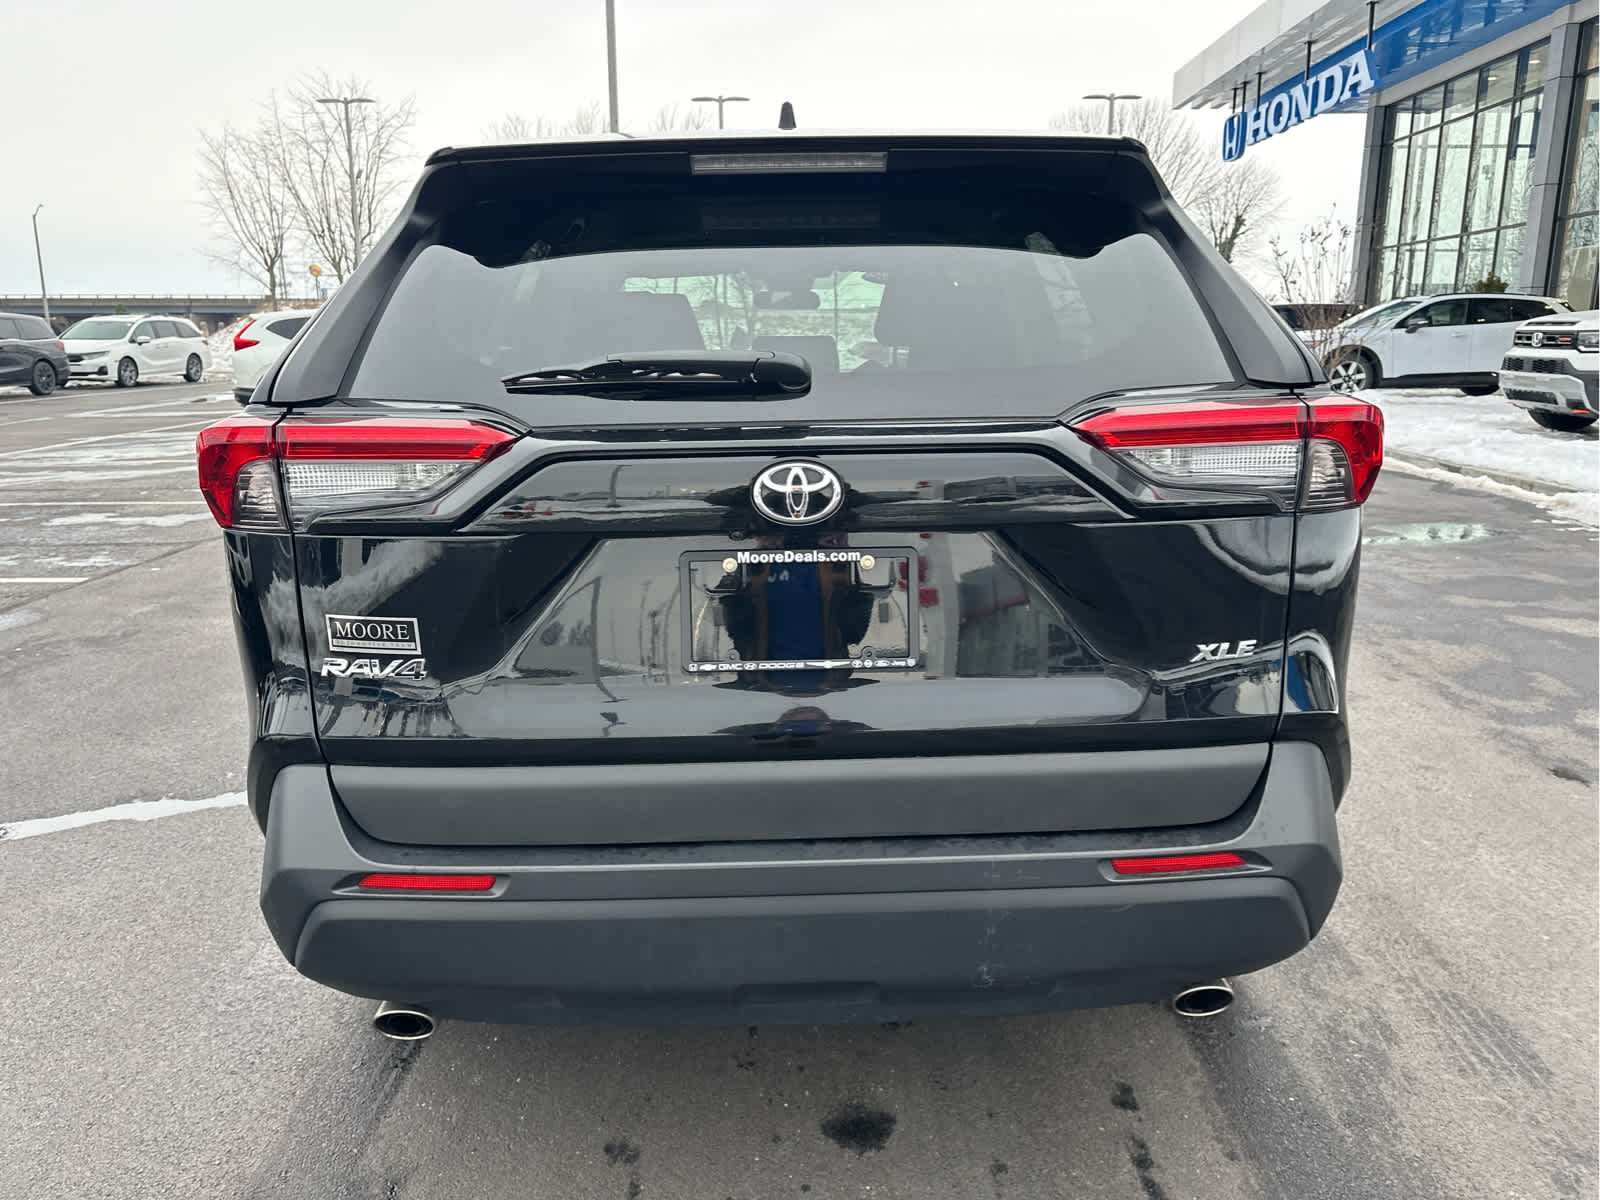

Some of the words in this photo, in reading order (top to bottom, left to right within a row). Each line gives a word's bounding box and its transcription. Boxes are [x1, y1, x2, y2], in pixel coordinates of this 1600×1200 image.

[1246, 49, 1376, 145] HONDA
[737, 550, 861, 564] MooreDeals.com
[335, 622, 409, 639] MOORE
[1189, 639, 1256, 662] XLE
[320, 657, 428, 681] RAV4
